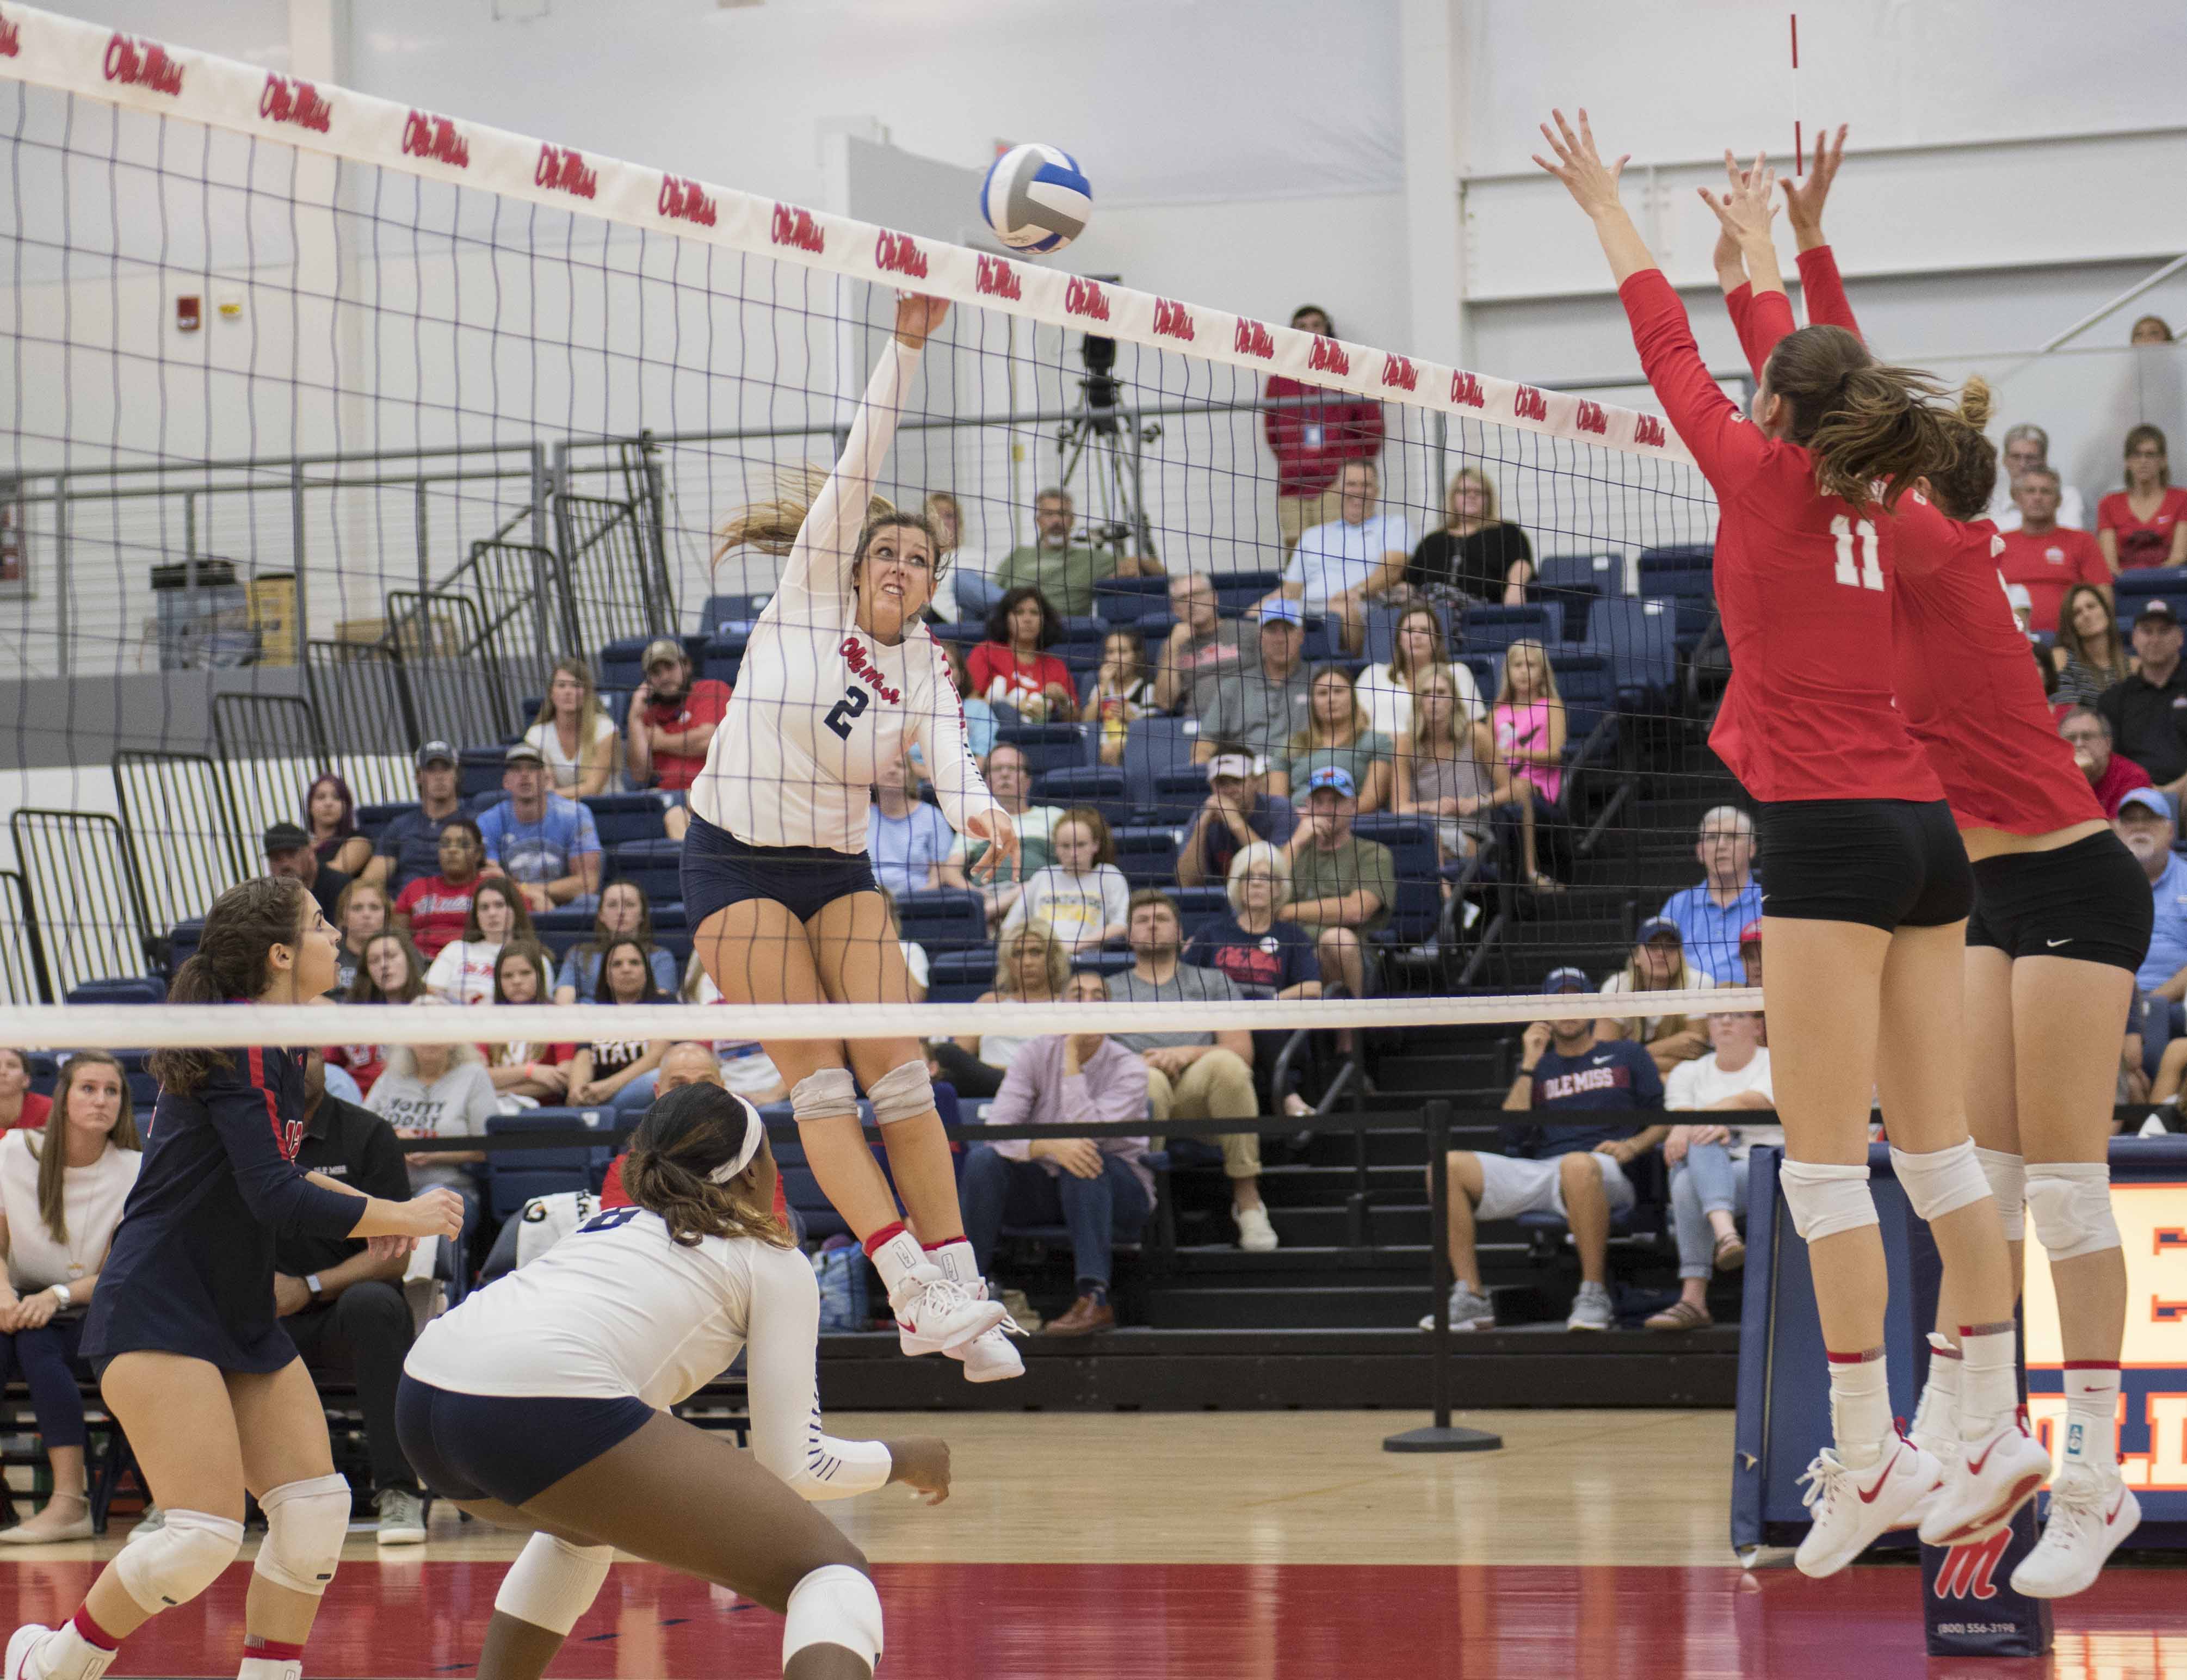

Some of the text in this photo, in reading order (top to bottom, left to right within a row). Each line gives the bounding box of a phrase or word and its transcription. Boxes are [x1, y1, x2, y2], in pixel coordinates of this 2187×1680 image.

[104, 34, 183, 96] Ole Miss
[261, 74, 330, 133] Ole Miss
[402, 110, 468, 168] Ole Miss
[535, 145, 596, 199] Ole Miss
[658, 175, 716, 226] Ole Miss
[771, 203, 824, 252] Ole Miss
[876, 230, 928, 279] Ole Miss
[976, 255, 1021, 300] Ole Miss
[1066, 277, 1109, 320] Ole Miss
[1153, 298, 1194, 341] Ole Miss
[1235, 318, 1273, 359] Ole Miss
[1308, 336, 1349, 375] Ole Miss
[1382, 354, 1417, 391] Ole Miss
[1451, 372, 1484, 407] Ole Miss
[1515, 387, 1546, 421] Ole Miss
[1577, 400, 1607, 435] Ole Miss
[1634, 415, 1665, 447] Ole Miss
[1830, 514, 1885, 591] 11
[839, 635, 900, 705] Ole Miss
[824, 685, 869, 740] 2
[1544, 1067, 1614, 1100] OLE MISS
[1933, 1525, 2014, 1599] M
